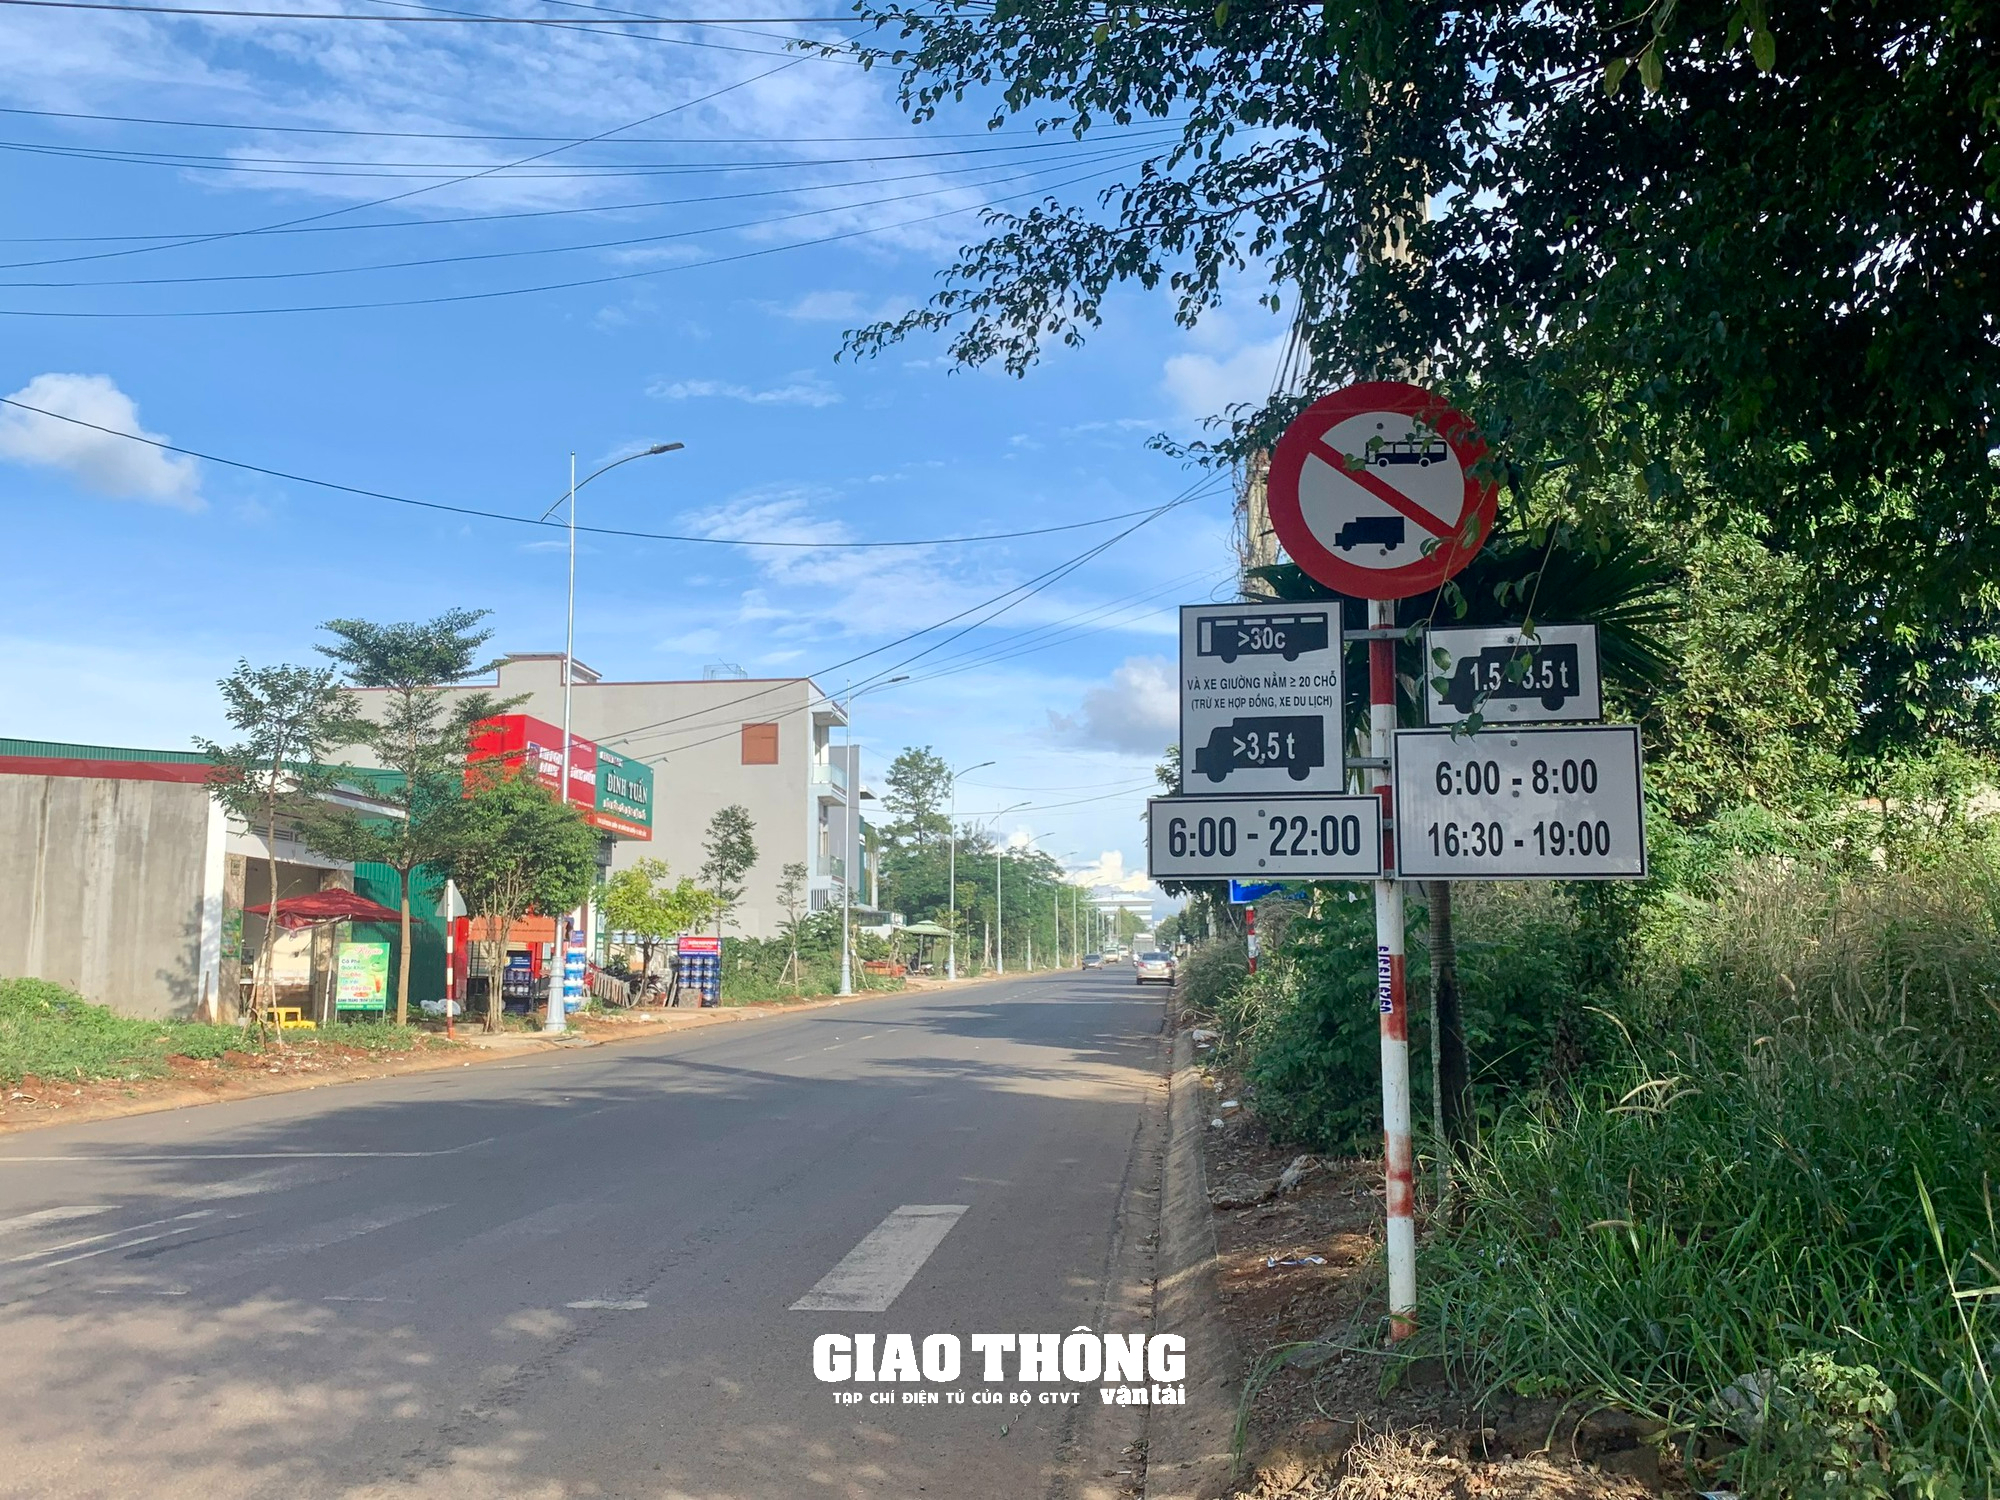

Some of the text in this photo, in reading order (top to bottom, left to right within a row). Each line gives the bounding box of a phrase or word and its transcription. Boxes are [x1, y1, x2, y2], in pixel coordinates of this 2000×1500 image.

[1237, 626, 1286, 650] >30c
[1187, 676, 1201, 691] VÀ
[1204, 678, 1217, 690] XE
[1220, 675, 1261, 690] GIƯỜNG
[1264, 671, 1287, 688] NẰM
[1299, 675, 1311, 688] 20
[1313, 670, 1337, 687] CHỖ
[1470, 660, 1569, 691] 1.5 3.5 t
[1191, 696, 1212, 711] (TRỪ
[1214, 698, 1225, 709] XE
[1228, 697, 1246, 710] HỢP
[1279, 696, 1291, 707] XE
[1293, 695, 1306, 707] DU
[1309, 694, 1333, 708] LỊCH)
[1232, 731, 1295, 760] >3.5 t
[607, 769, 627, 797] ĐÌNH
[1436, 758, 1598, 796] 6:00 - 8:00
[1168, 814, 1361, 858] 6:00 - 22:00
[1428, 820, 1611, 858] 16:30 - 19:00
